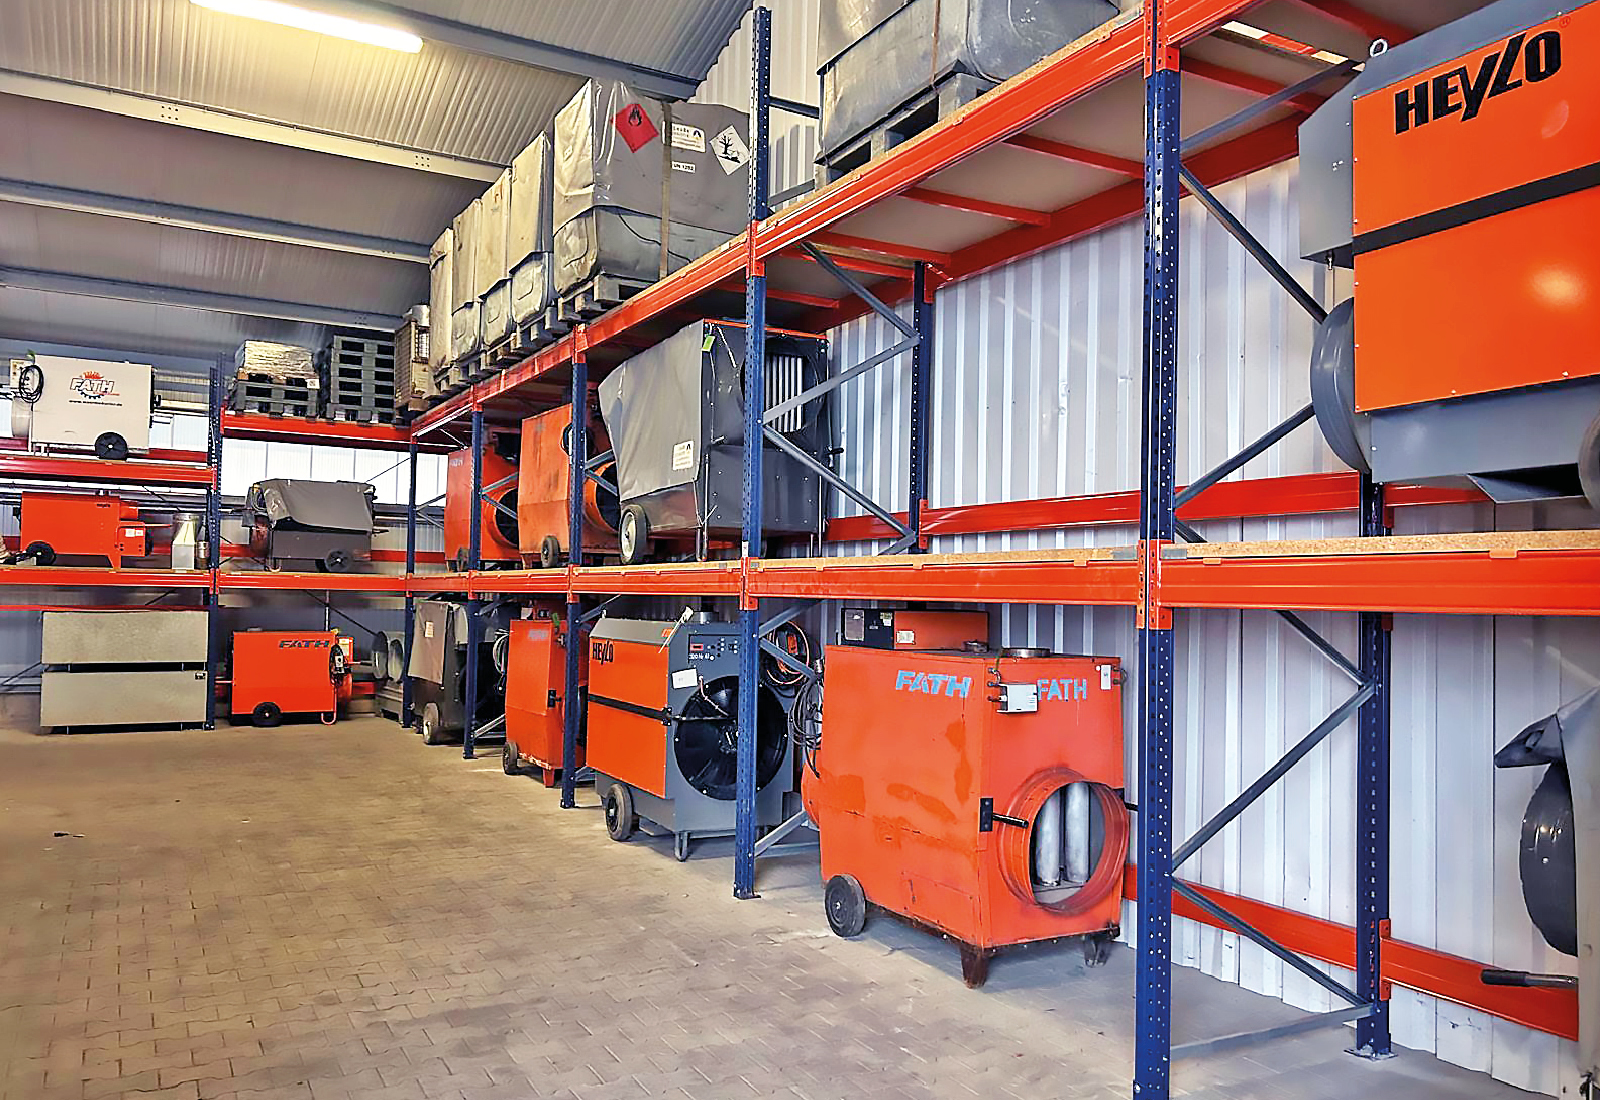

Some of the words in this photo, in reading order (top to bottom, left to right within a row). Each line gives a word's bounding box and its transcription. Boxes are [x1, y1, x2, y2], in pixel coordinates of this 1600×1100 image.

[1395, 30, 1562, 135] HEYLO
[70, 378, 115, 393] FATH
[279, 640, 330, 648] FATH
[592, 640, 614, 665] HEYLO
[895, 669, 972, 698] FATH
[1037, 678, 1087, 702] FATH
